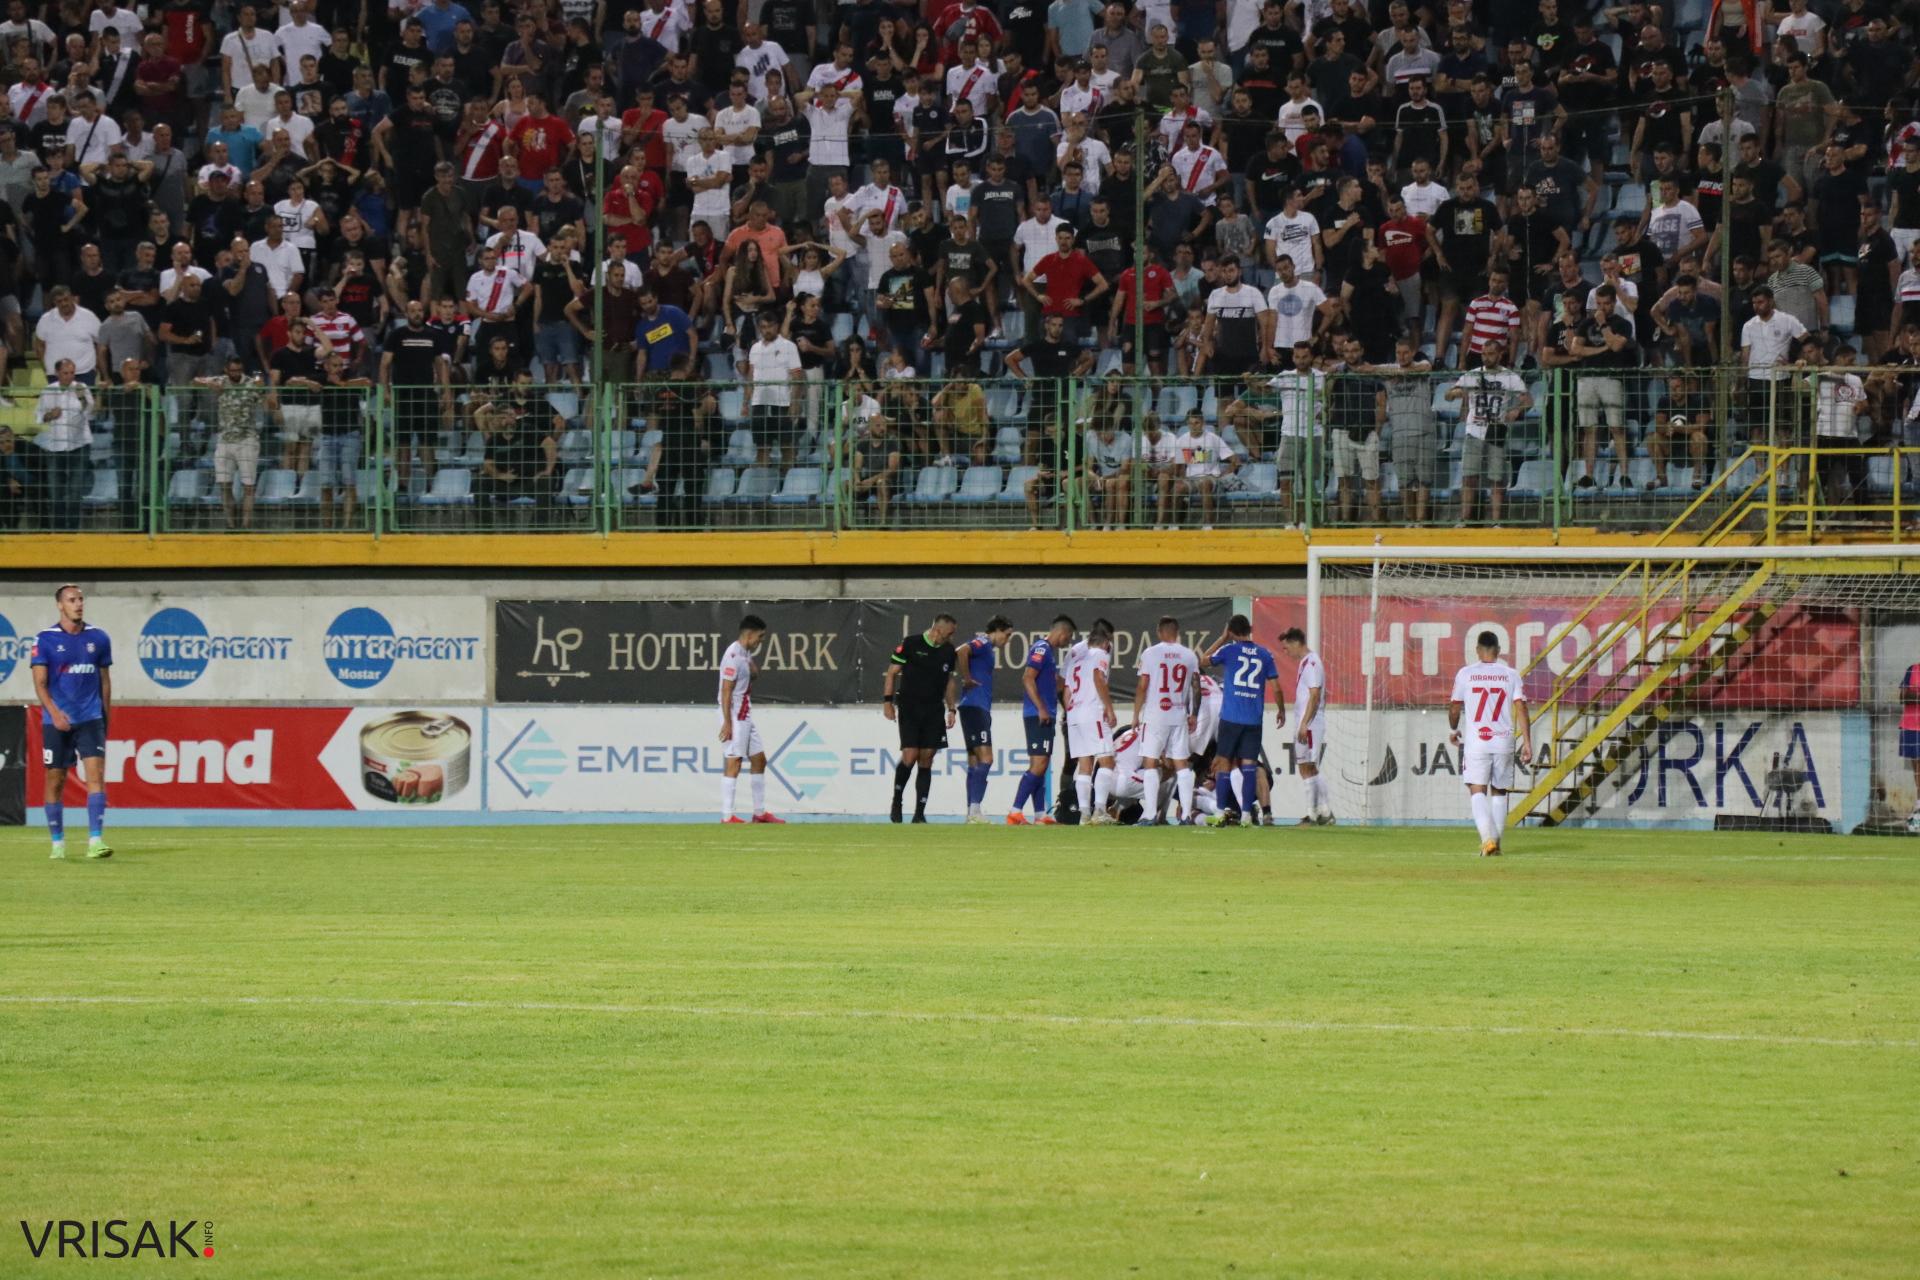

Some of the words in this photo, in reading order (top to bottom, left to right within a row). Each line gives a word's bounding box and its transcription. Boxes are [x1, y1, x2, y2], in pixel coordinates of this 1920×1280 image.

[1361, 622, 1452, 676] HT
[153, 668, 199, 680] Mostar
[338, 668, 382, 680] Mostar
[1072, 671, 1081, 693] 5
[1159, 663, 1188, 693] 19
[1233, 656, 1263, 689] 22
[1472, 687, 1507, 722] 77
[980, 731, 988, 743] 9
[1043, 739, 1050, 753] 4
